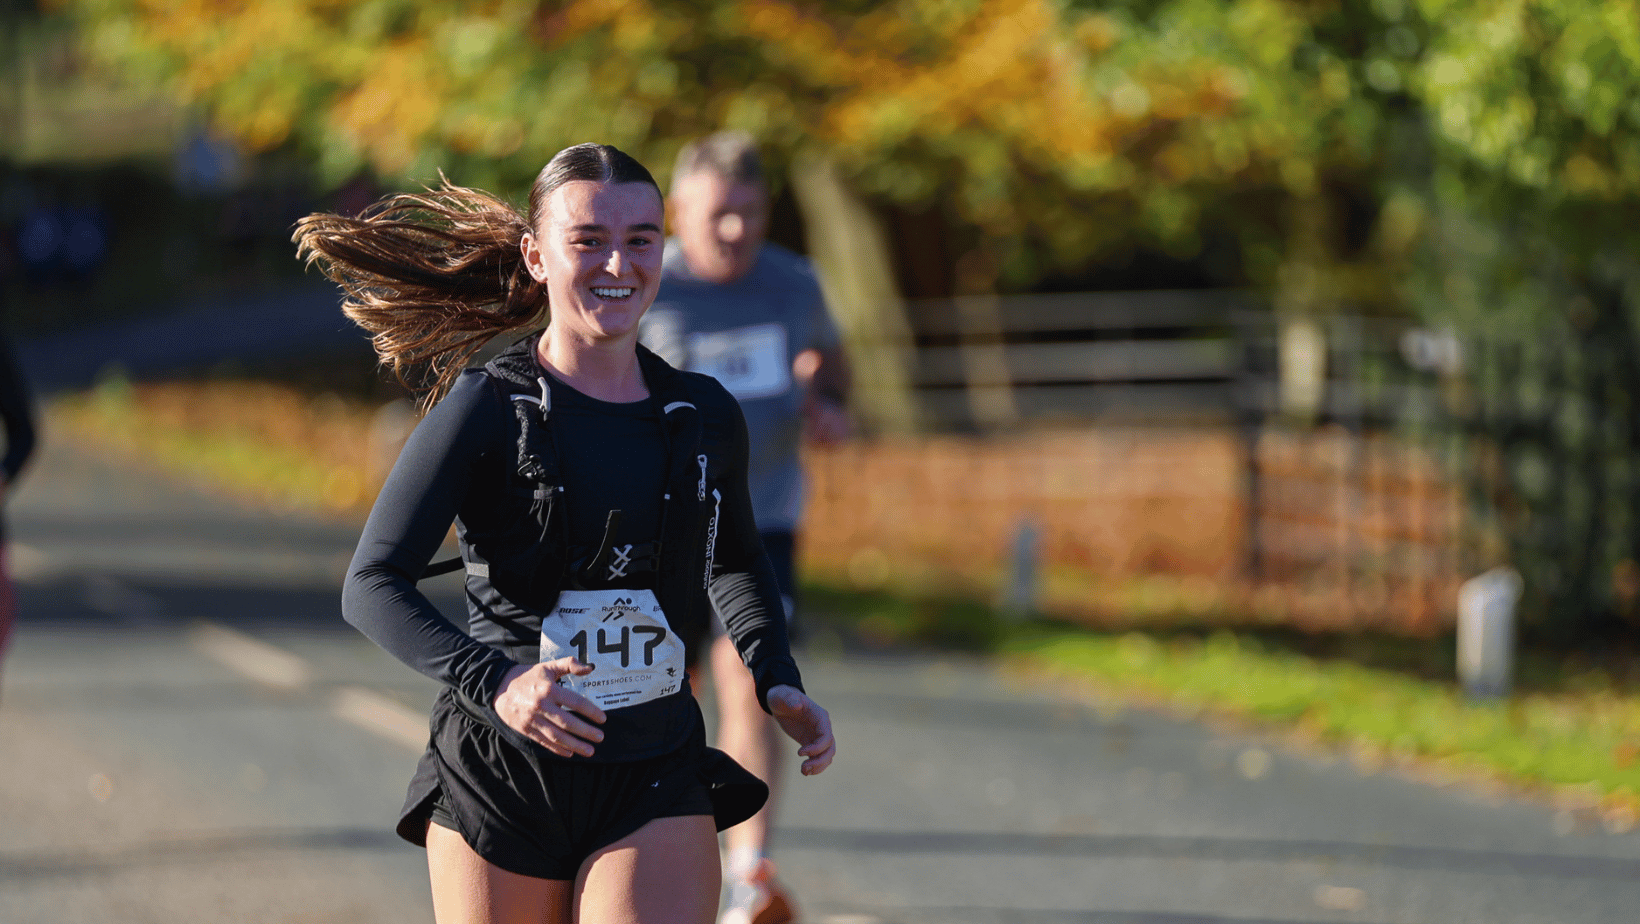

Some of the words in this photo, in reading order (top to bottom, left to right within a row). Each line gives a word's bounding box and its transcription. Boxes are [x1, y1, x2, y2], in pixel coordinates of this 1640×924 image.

[601, 605, 641, 613] RunThrough
[569, 625, 667, 668] 147
[660, 684, 676, 696] 147
